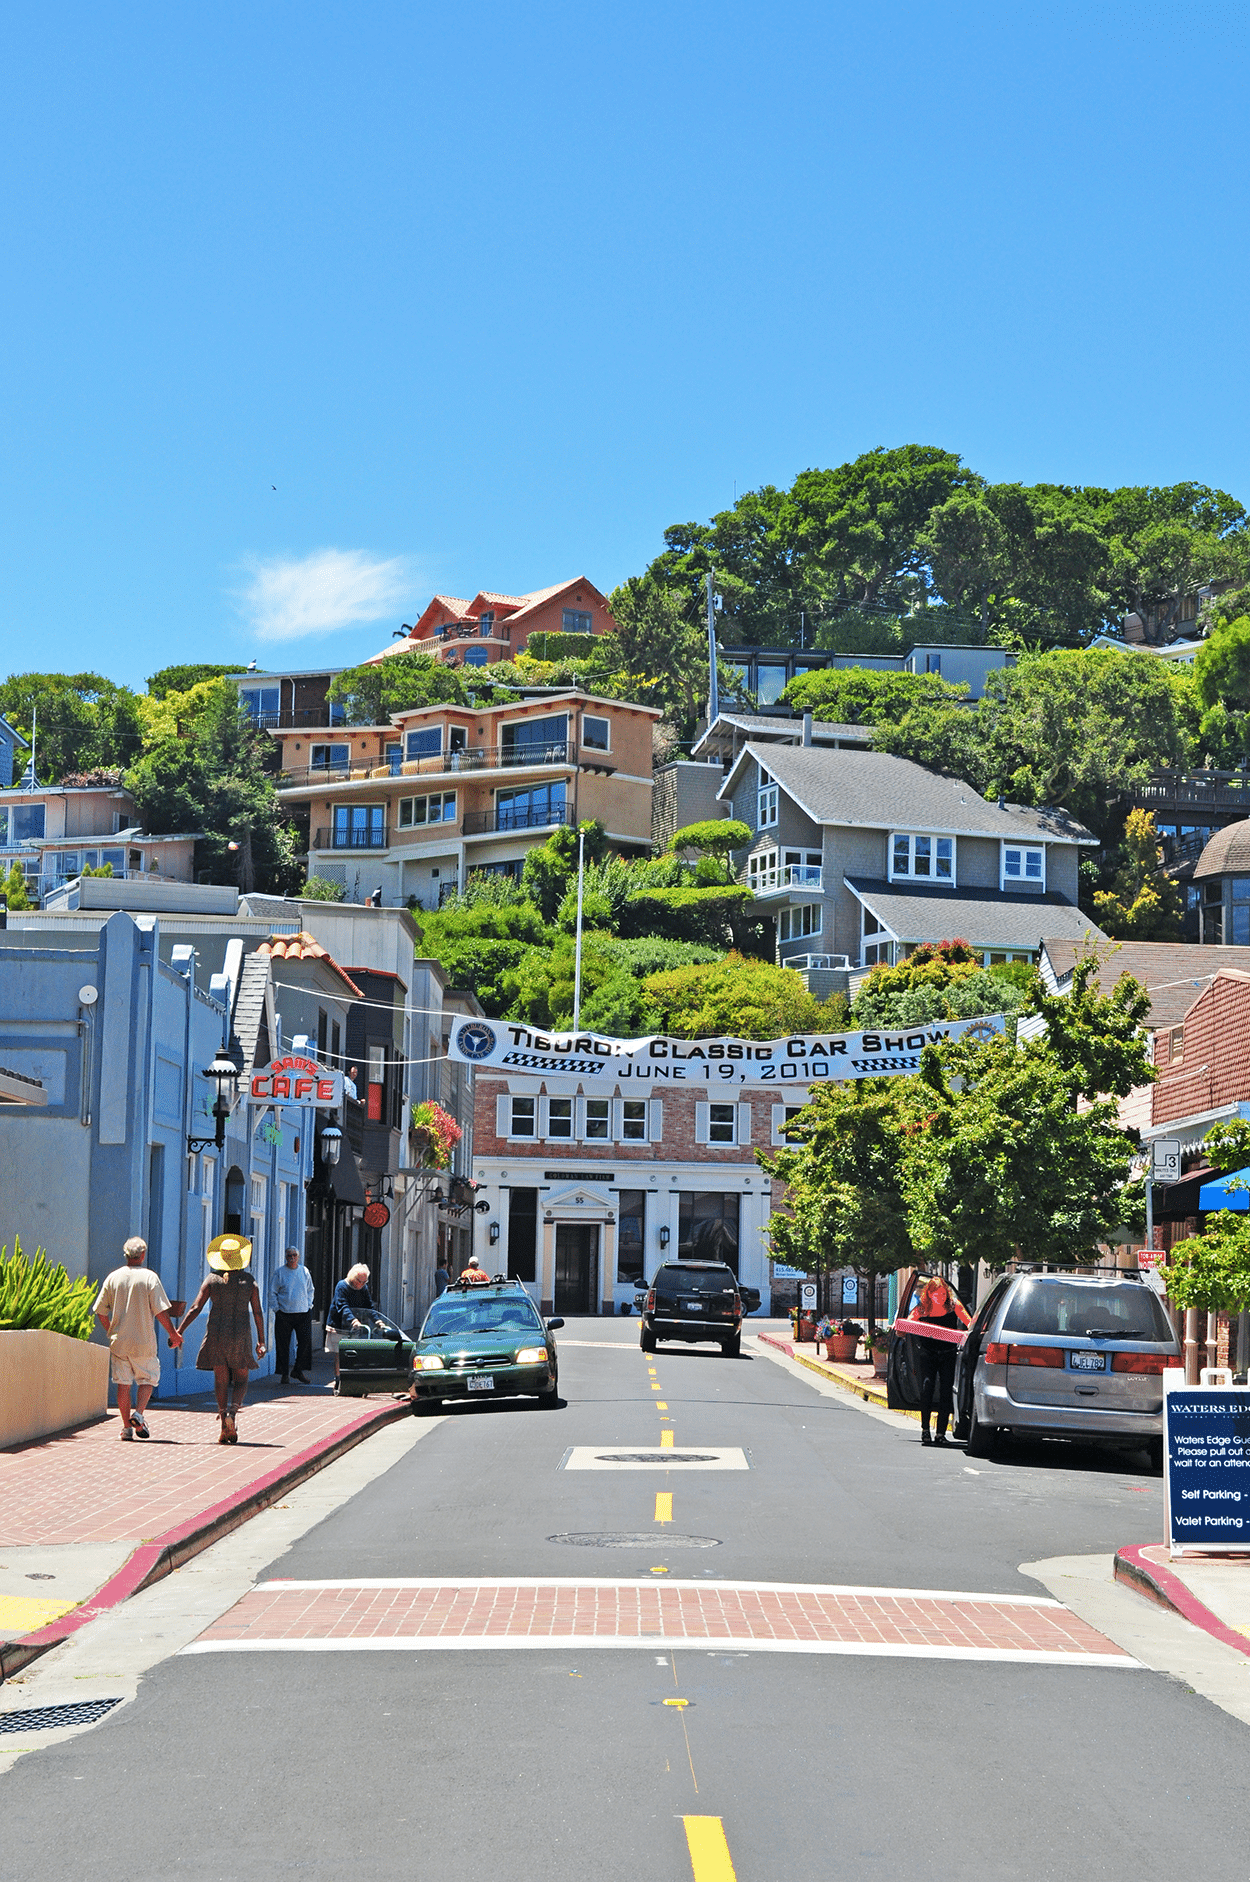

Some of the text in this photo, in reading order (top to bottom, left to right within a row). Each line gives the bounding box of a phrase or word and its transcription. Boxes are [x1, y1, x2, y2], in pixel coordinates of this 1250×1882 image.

[649, 1039, 772, 1060] CLASSIC
[787, 1039, 849, 1058] CAR
[862, 1030, 950, 1053] SHOW
[618, 1062, 829, 1082] JUNE 19, 2010
[251, 1075, 334, 1100] CAFE
[1168, 1156, 1176, 1168] 3
[1171, 1404, 1226, 1413] WATERS
[1174, 1435, 1205, 1444] Waters
[1207, 1435, 1231, 1446] Edge
[1178, 1447, 1208, 1456] Please
[1210, 1447, 1226, 1457] pull
[1228, 1447, 1243, 1456] out
[1174, 1458, 1193, 1467] wait
[1195, 1458, 1207, 1467] for
[1181, 1489, 1200, 1499] Self
[1203, 1489, 1241, 1501] Parking
[1175, 1515, 1202, 1526] Valet
[1205, 1515, 1243, 1528] Parking
